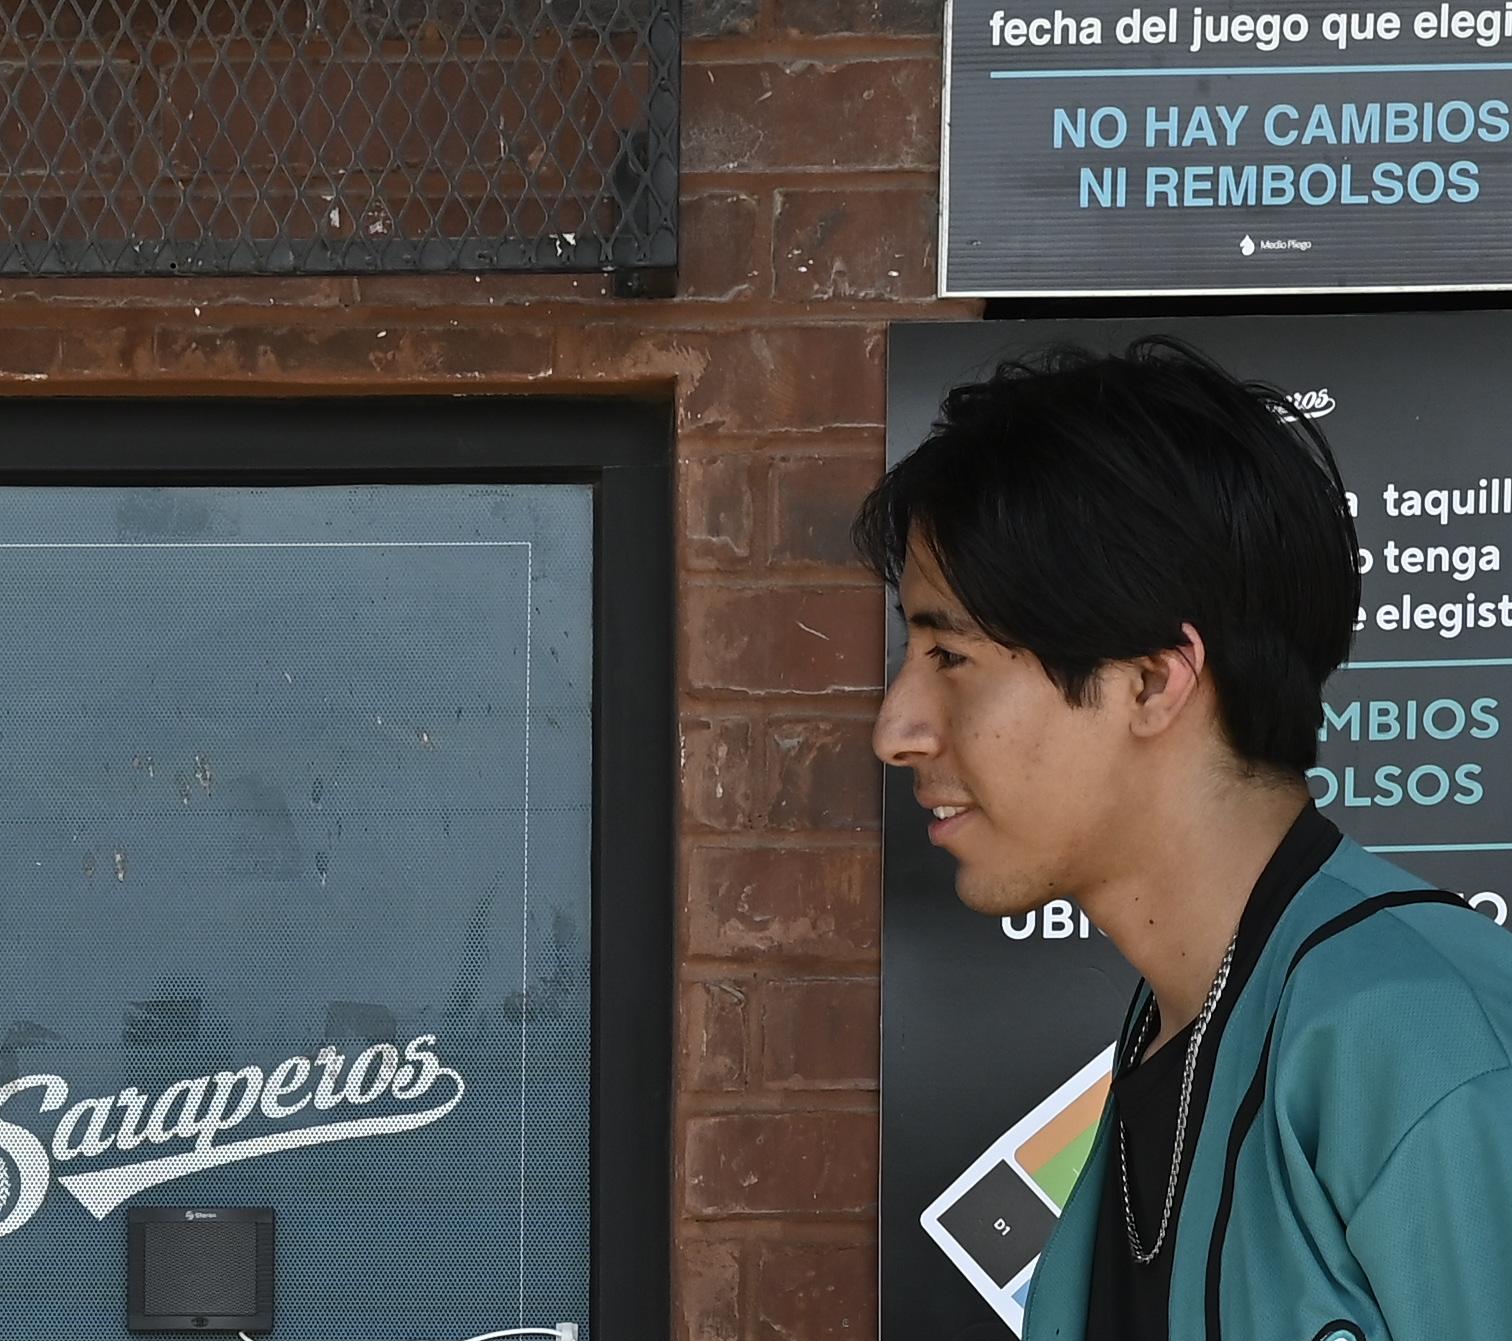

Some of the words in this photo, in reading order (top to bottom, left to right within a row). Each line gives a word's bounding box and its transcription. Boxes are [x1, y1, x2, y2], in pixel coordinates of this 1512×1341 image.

[990, 10, 1102, 46] fecha
[1115, 7, 1177, 45] del
[1190, 7, 1309, 52] juego
[1321, 9, 1401, 50] que
[1052, 106, 1128, 150] NO
[1145, 104, 1249, 148] HAY
[1263, 99, 1511, 146] CAMBIOS
[1079, 166, 1126, 208] NI
[1145, 161, 1480, 208] REMBOLSOS
[1383, 540, 1500, 581] tenga
[1318, 697, 1500, 742] MBIOS
[1304, 763, 1484, 809] OLSOS
[1001, 899, 1110, 940] UBI
[993, 1217, 1012, 1237] D1
